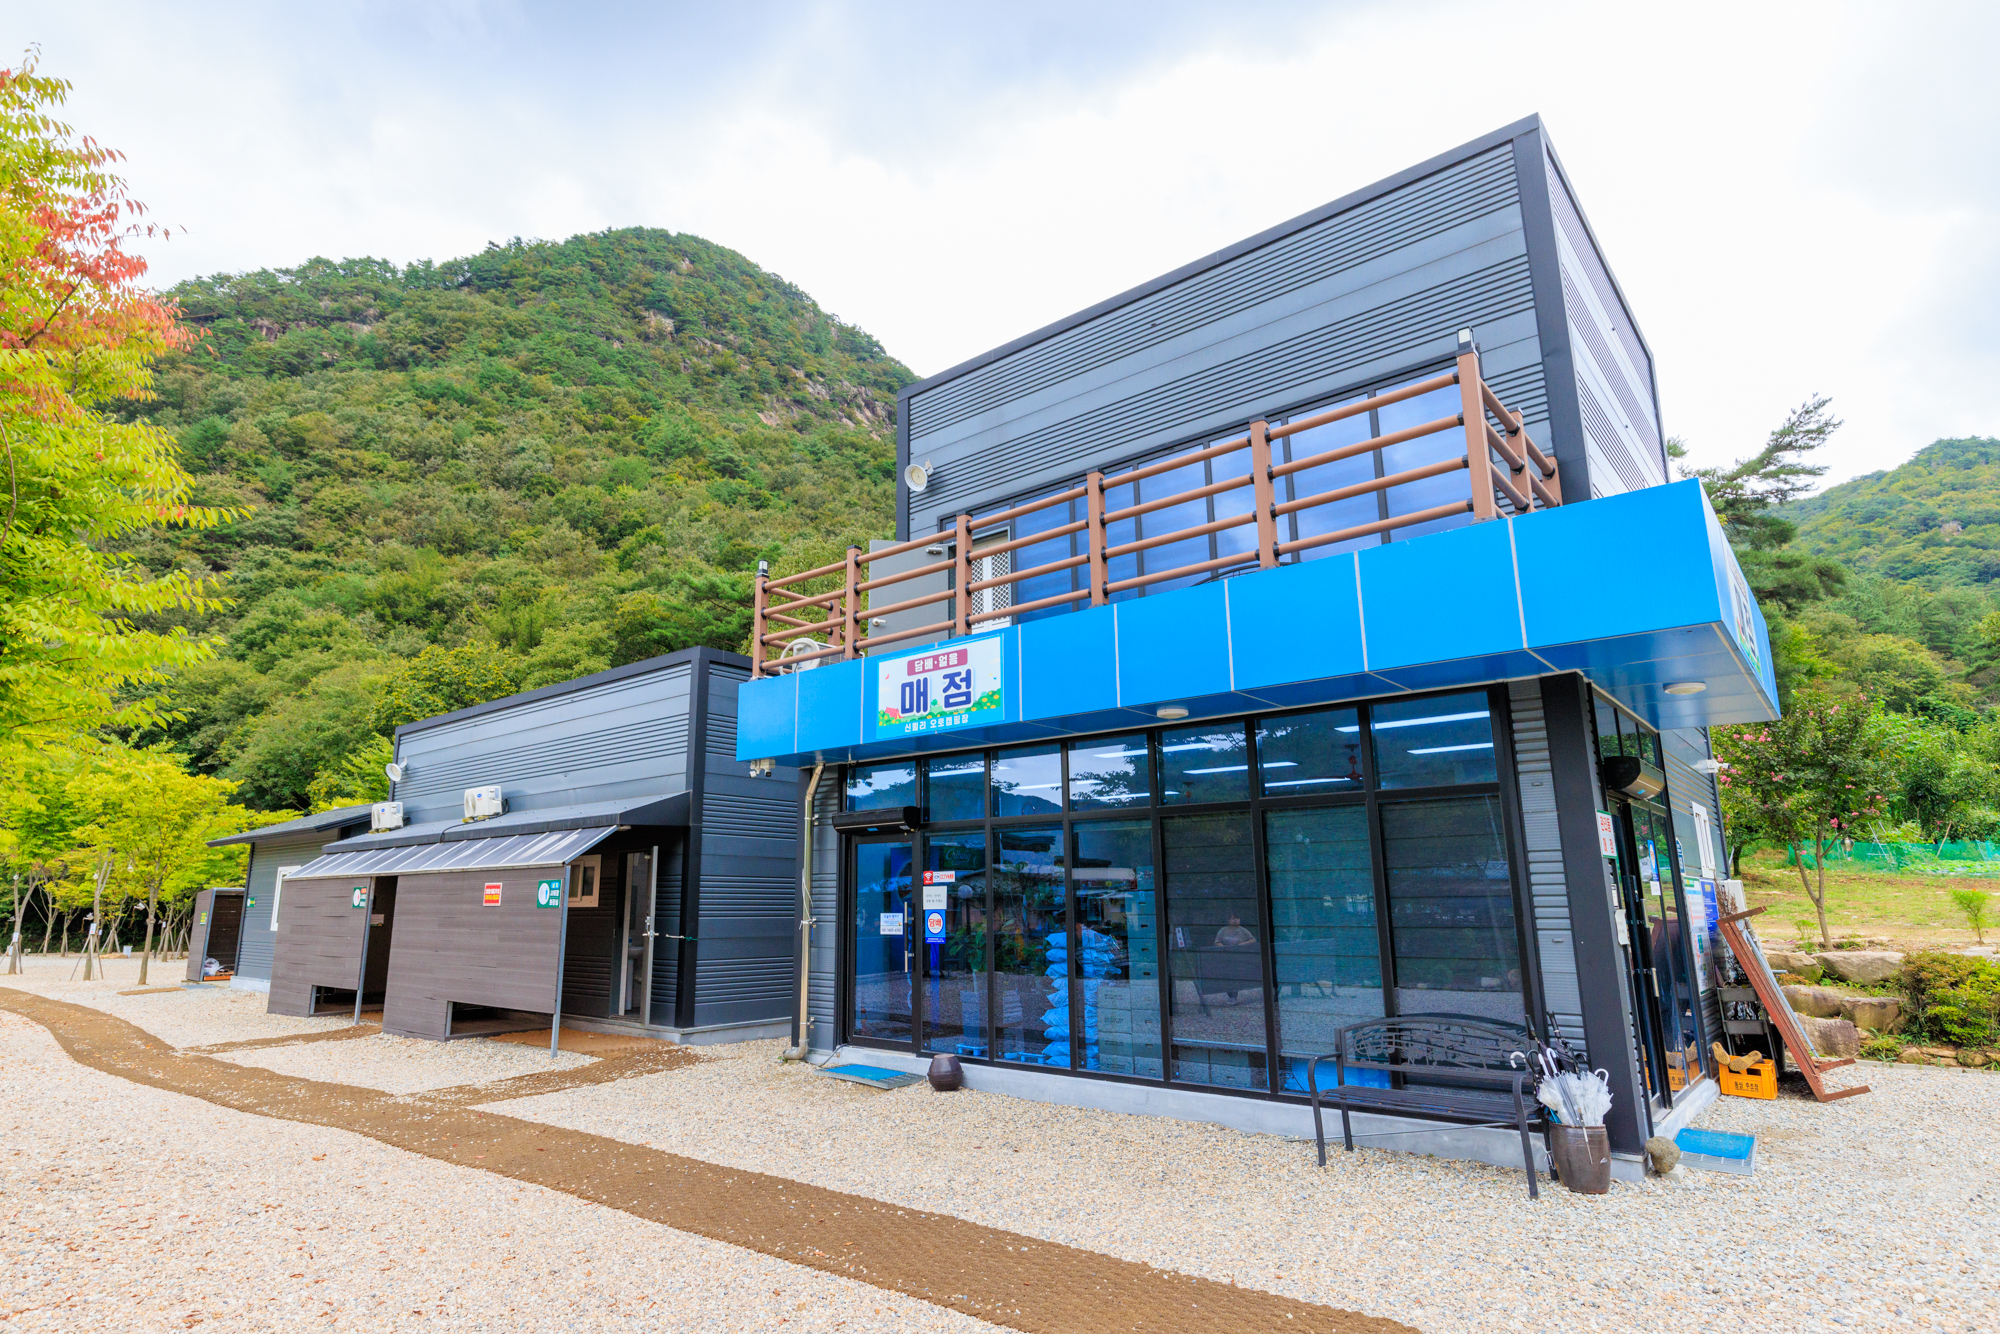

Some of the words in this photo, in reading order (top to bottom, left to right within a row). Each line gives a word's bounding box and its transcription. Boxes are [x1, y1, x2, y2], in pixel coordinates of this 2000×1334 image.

[914, 653, 958, 672] 담배·얼음
[901, 668, 971, 714] 매점
[930, 714, 969, 728] 오토캠핑장
[928, 918, 941, 927] 담배
